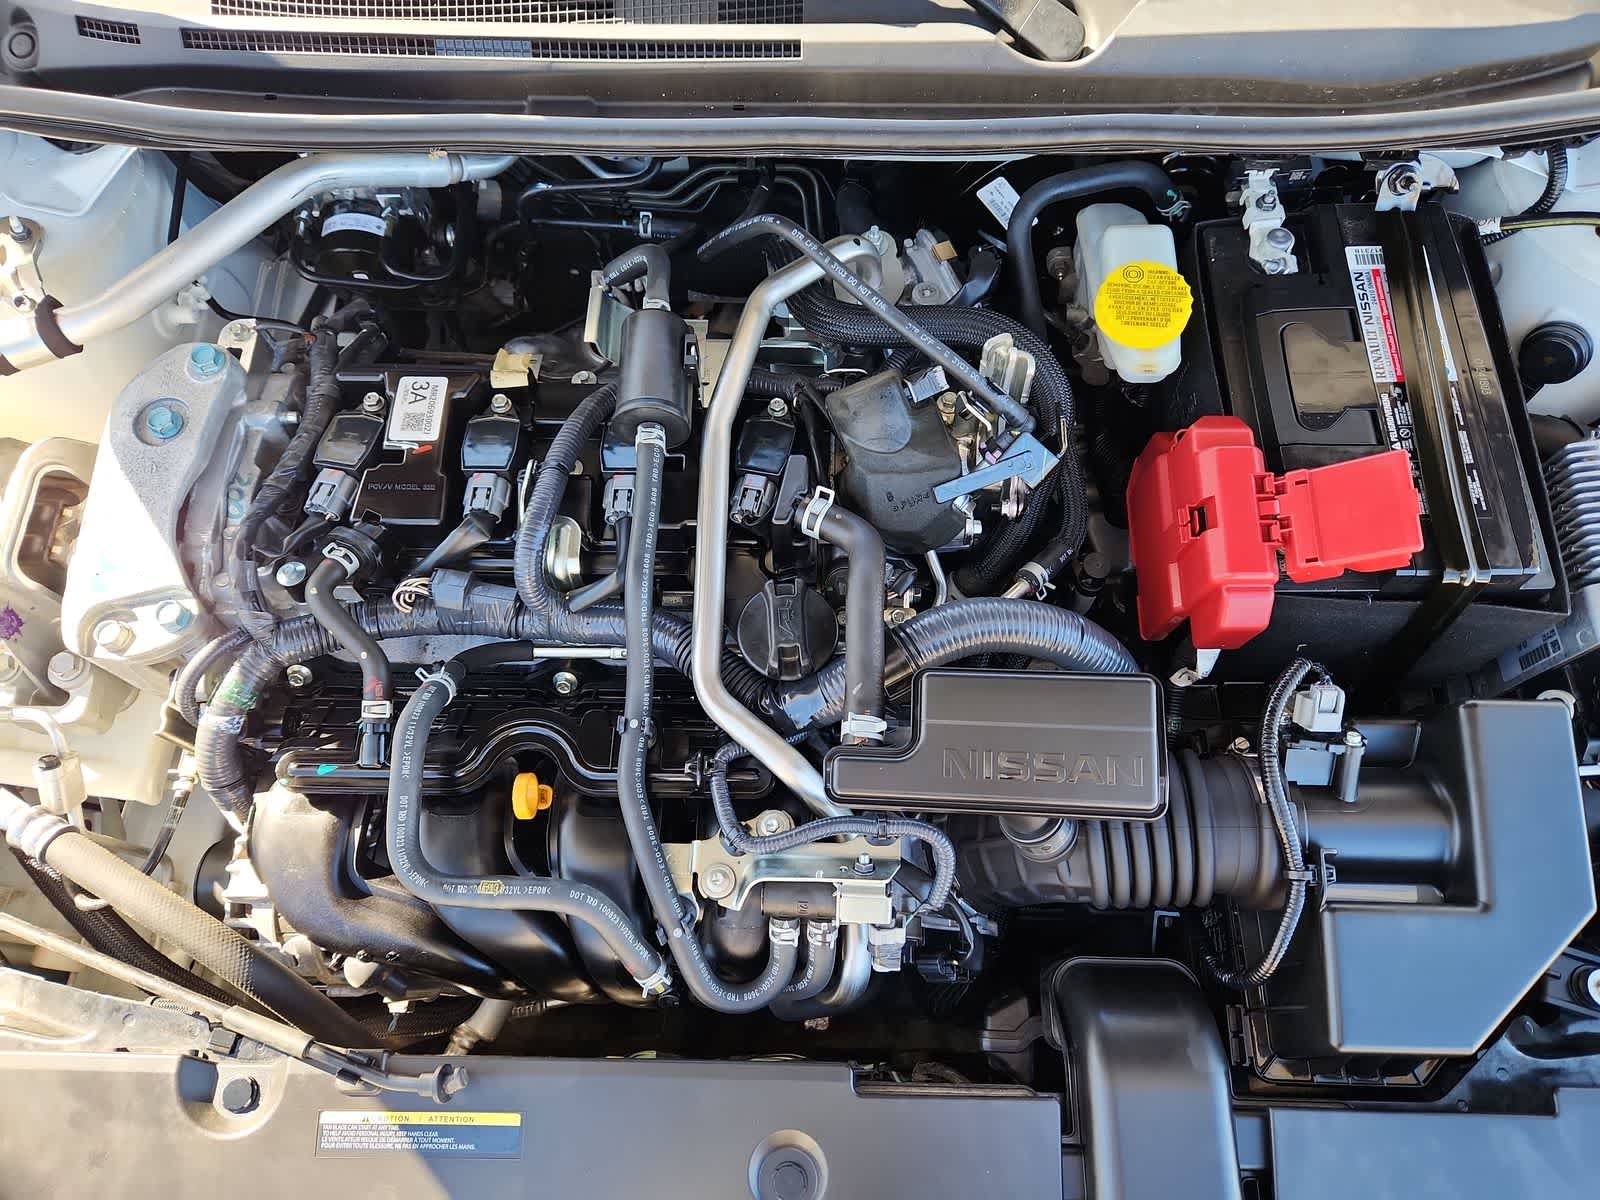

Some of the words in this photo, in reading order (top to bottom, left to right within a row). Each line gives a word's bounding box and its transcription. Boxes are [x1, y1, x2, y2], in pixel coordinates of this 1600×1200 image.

[1353, 271, 1374, 325] NISSAN
[1366, 328, 1386, 379] RENAULT
[408, 381, 430, 405] 3A
[943, 748, 1144, 787] NISSAN
[569, 889, 584, 901] DOT
[428, 1115, 475, 1123] ATTENTION
